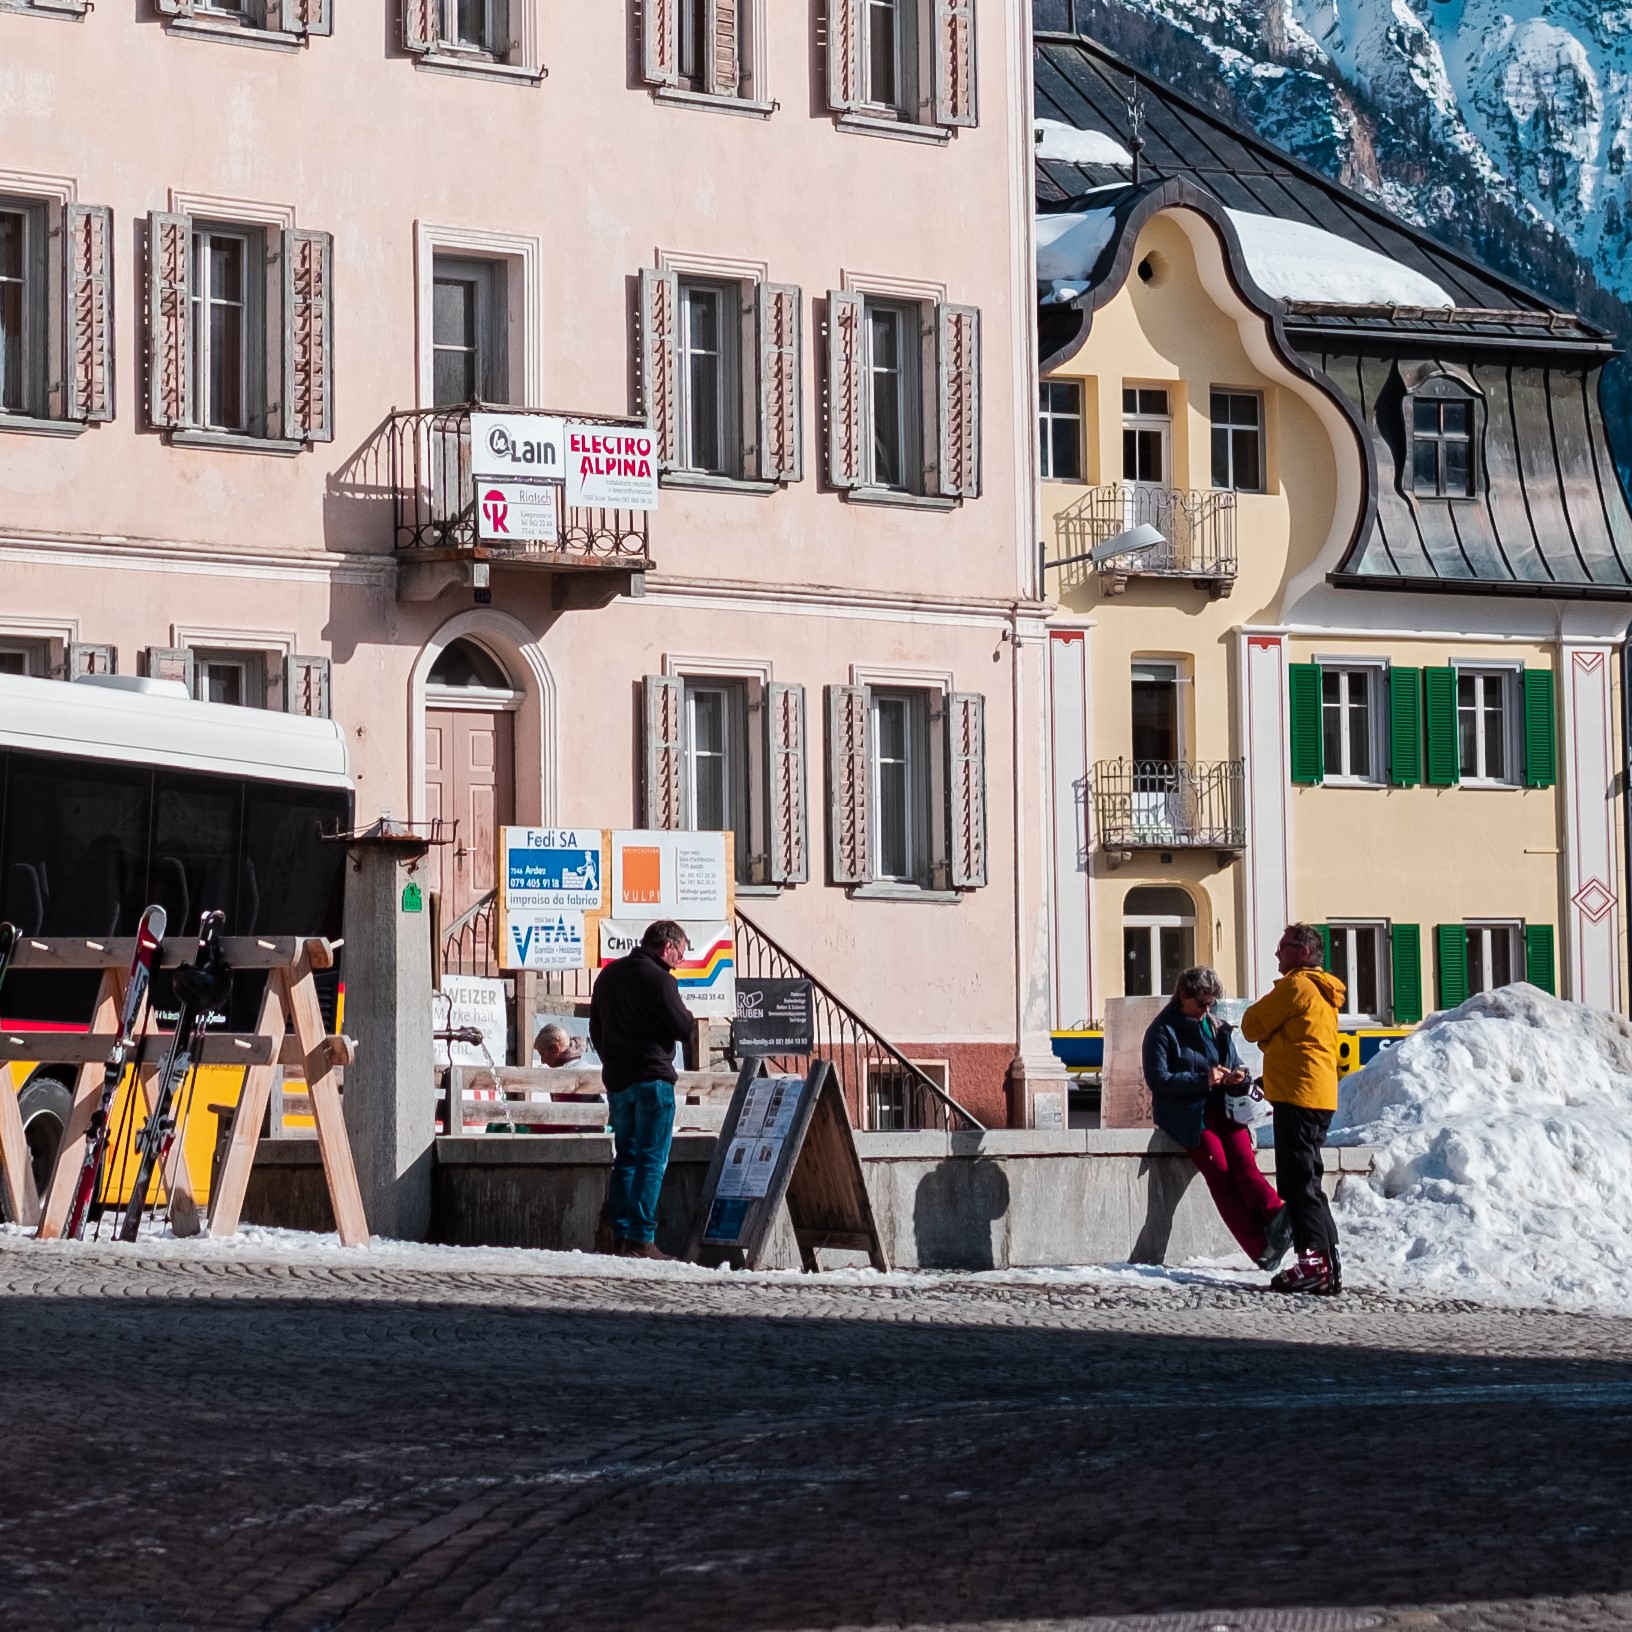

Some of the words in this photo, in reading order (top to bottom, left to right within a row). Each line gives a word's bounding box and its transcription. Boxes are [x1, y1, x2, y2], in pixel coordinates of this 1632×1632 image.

[570, 434, 652, 457] ELECTRO
[579, 456, 652, 479] ALPINA
[519, 489, 551, 504] Riatsch
[527, 830, 555, 848] Fedi
[559, 832, 578, 848] SA
[510, 878, 525, 888] 079
[510, 893, 550, 907] impraisa
[553, 894, 564, 905] da
[567, 893, 598, 906] fabrica
[623, 890, 660, 902] VULPI
[512, 914, 581, 966] VITAL
[439, 987, 497, 1005] WEIZER
[434, 1008, 470, 1021] Mrke
[737, 1008, 763, 1019] RUBEN
